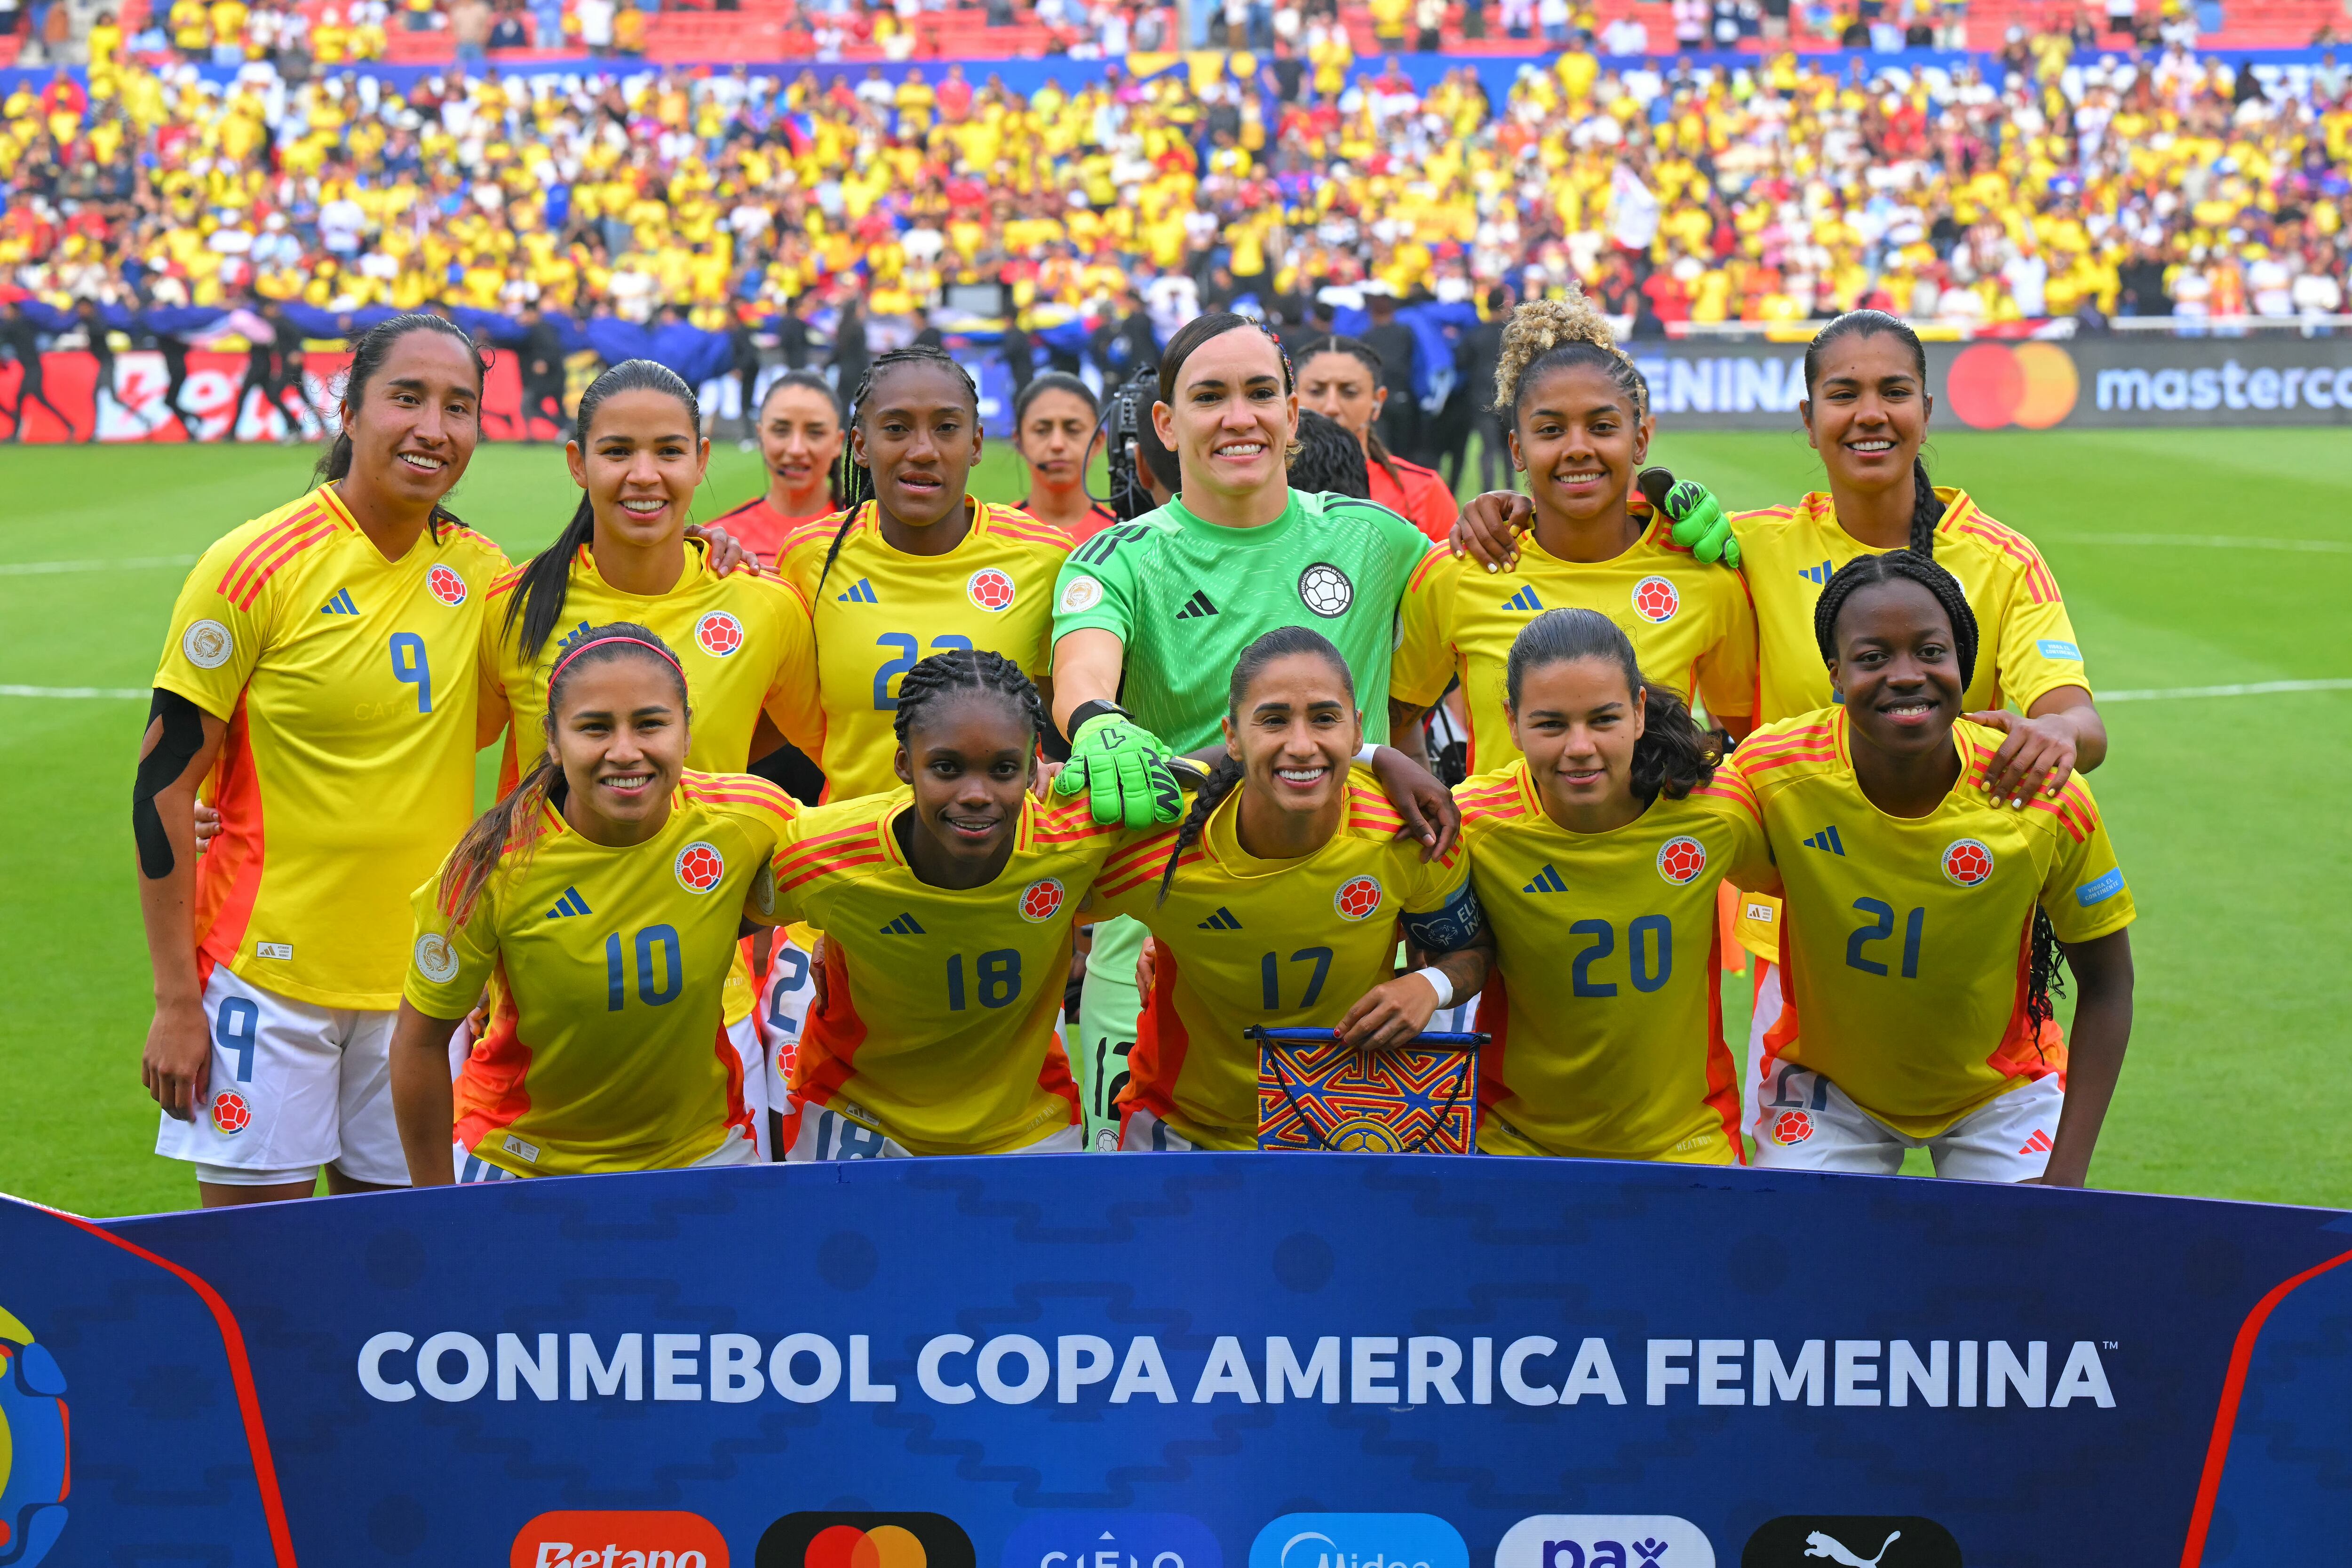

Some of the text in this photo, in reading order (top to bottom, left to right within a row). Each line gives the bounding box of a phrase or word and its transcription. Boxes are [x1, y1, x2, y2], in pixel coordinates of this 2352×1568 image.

[389, 632, 432, 713] 9
[684, 843, 706, 853] COLOMBIANA
[1346, 876, 1368, 885] COLOMBIANA
[2085, 880, 2119, 900] CONTINENTE
[2088, 883, 2106, 893] VIBRA
[605, 924, 683, 1012] 10
[1569, 914, 1672, 997] 20
[1846, 896, 1925, 979] 21
[946, 948, 1021, 1011] 18
[1261, 946, 1334, 1010] 17
[216, 996, 259, 1082] 9
[358, 1332, 896, 1403] CONMEBOL
[917, 1334, 1177, 1404] COPA
[1192, 1336, 1627, 1405] AMERICA
[1647, 1339, 2115, 1408] FEMENINA
[536, 1542, 707, 1568] Betano
